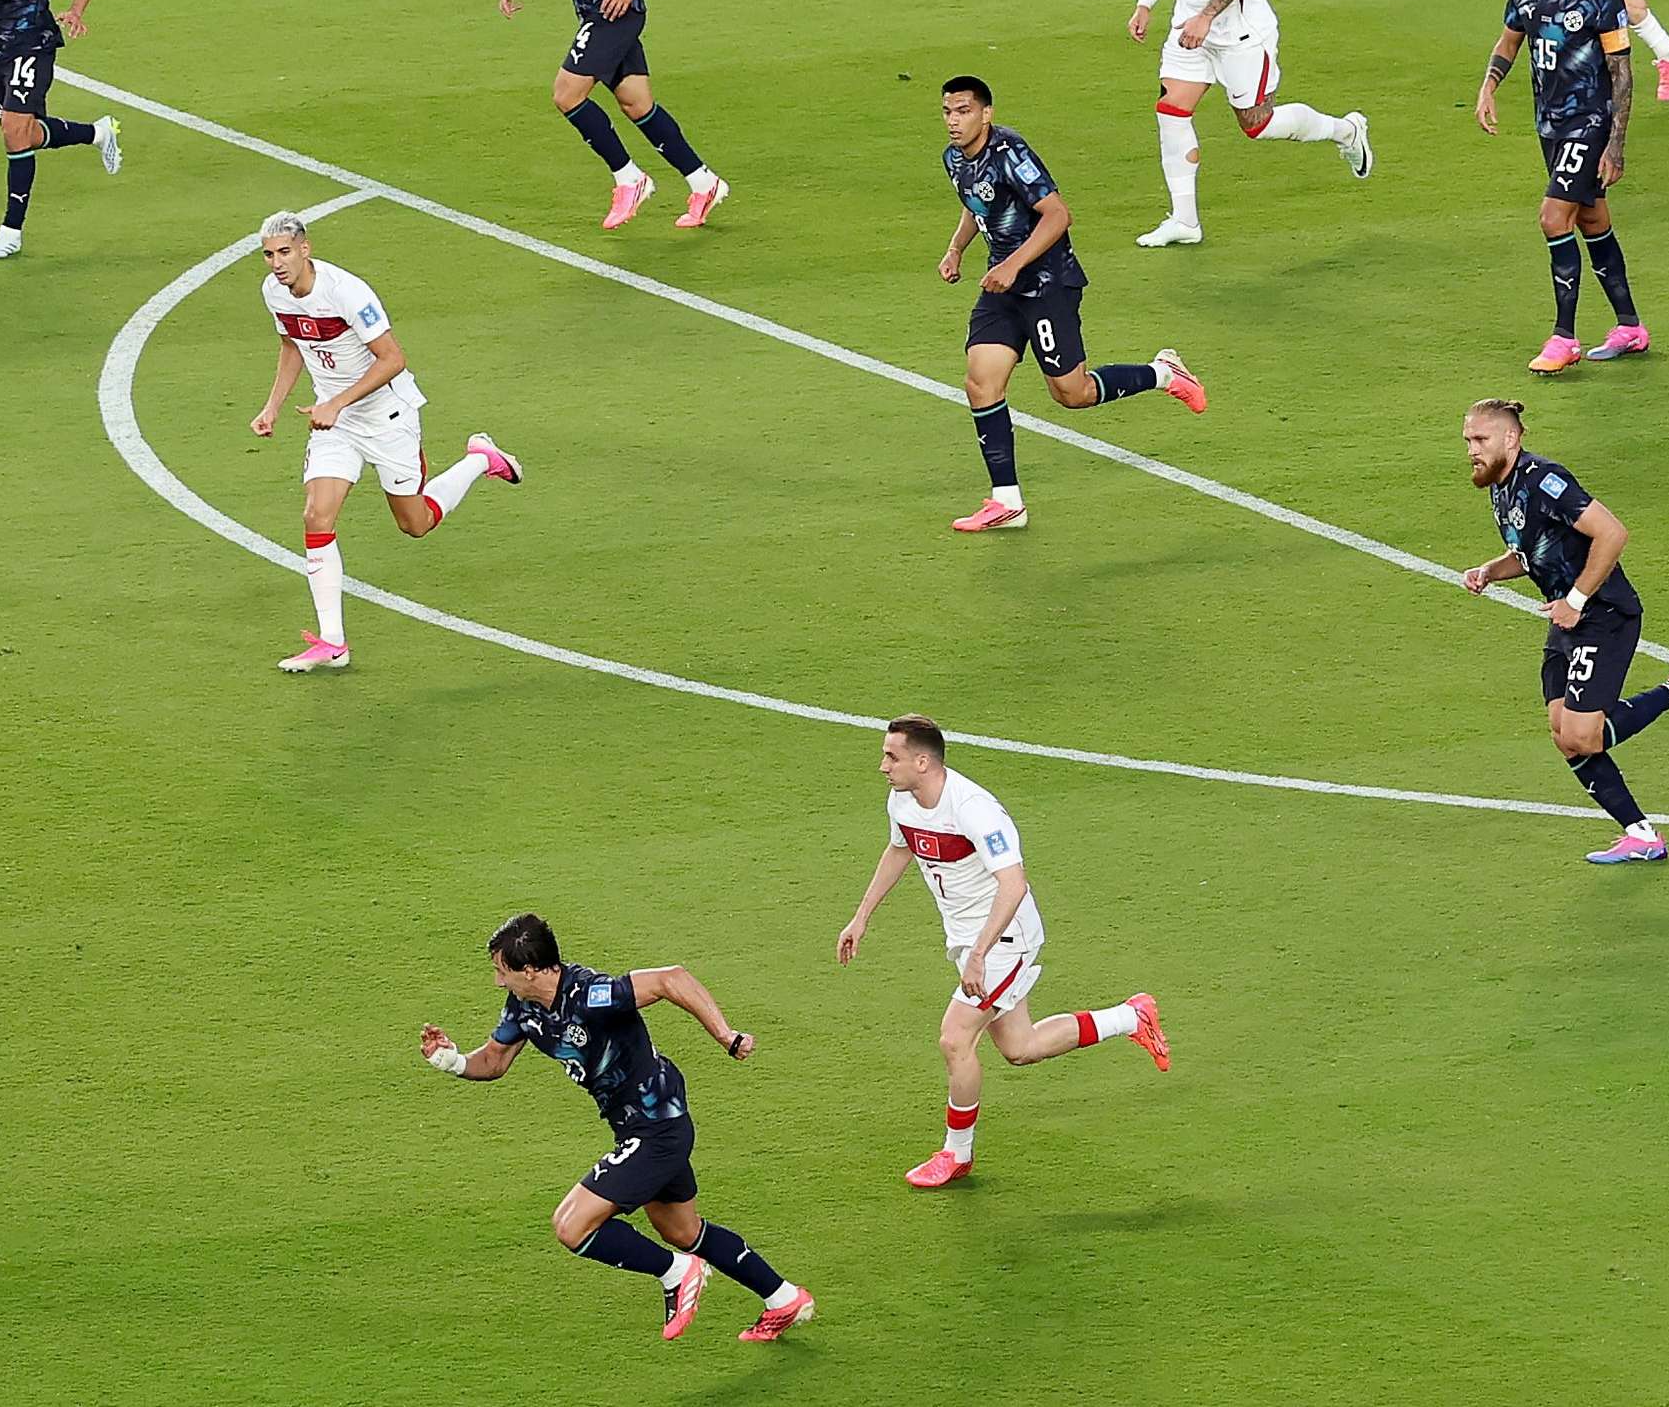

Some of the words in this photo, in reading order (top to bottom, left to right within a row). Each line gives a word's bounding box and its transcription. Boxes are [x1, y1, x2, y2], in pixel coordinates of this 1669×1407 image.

[576, 22, 594, 50] 4
[1536, 38, 1558, 71] 15
[10, 56, 36, 88] 14
[1555, 142, 1589, 174] 15
[1036, 318, 1055, 352] 8
[1567, 646, 1598, 682] 25
[933, 872, 947, 900] 7
